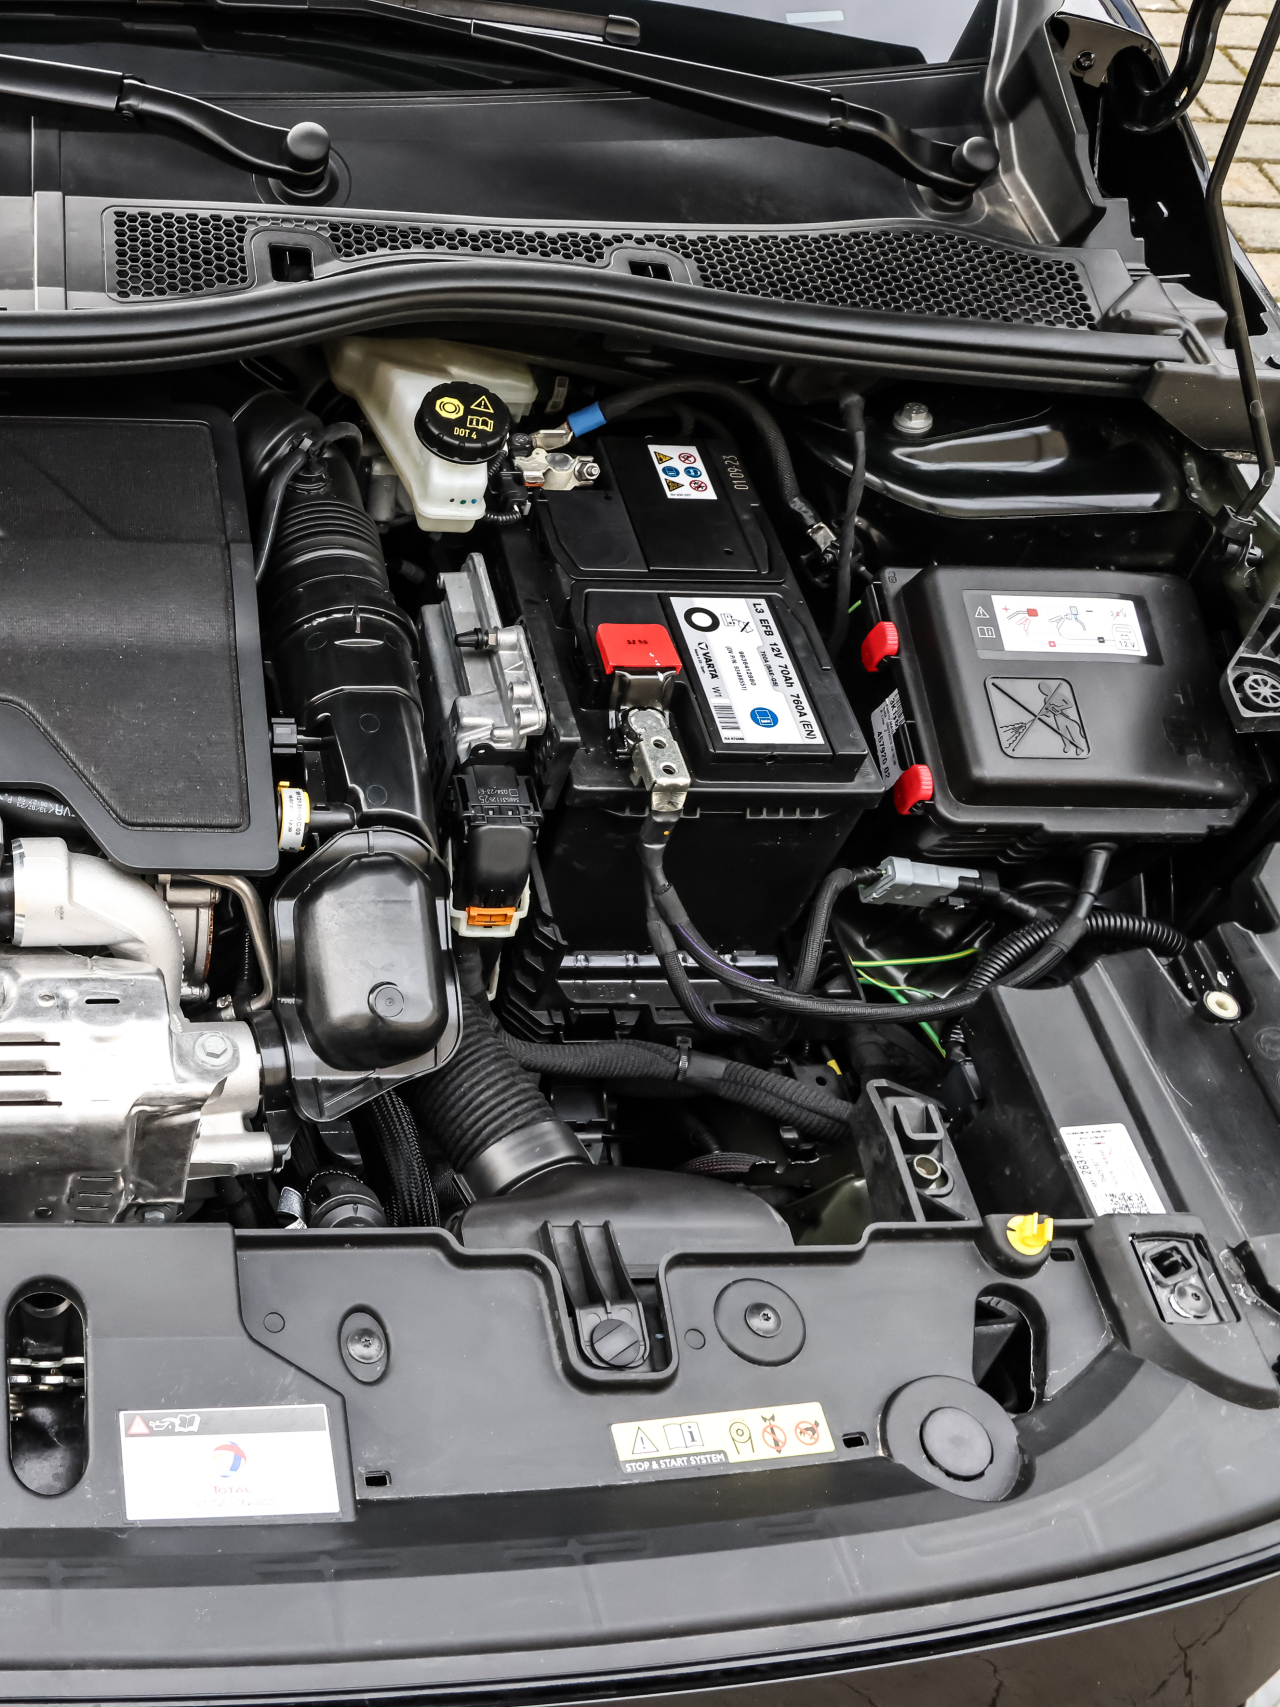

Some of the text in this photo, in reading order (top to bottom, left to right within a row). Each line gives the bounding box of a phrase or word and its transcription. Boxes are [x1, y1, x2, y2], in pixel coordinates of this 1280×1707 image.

[453, 427, 477, 440] DOT 4
[1118, 640, 1129, 648] 12
[702, 651, 722, 697] VARTA W1
[753, 602, 817, 740] L3 EFB 12V 70Ah 760A (EN)
[1074, 1155, 1092, 1175] 2637
[625, 1452, 725, 1473] STOP & START SYSTEM
[211, 1485, 253, 1495] TOTAL
